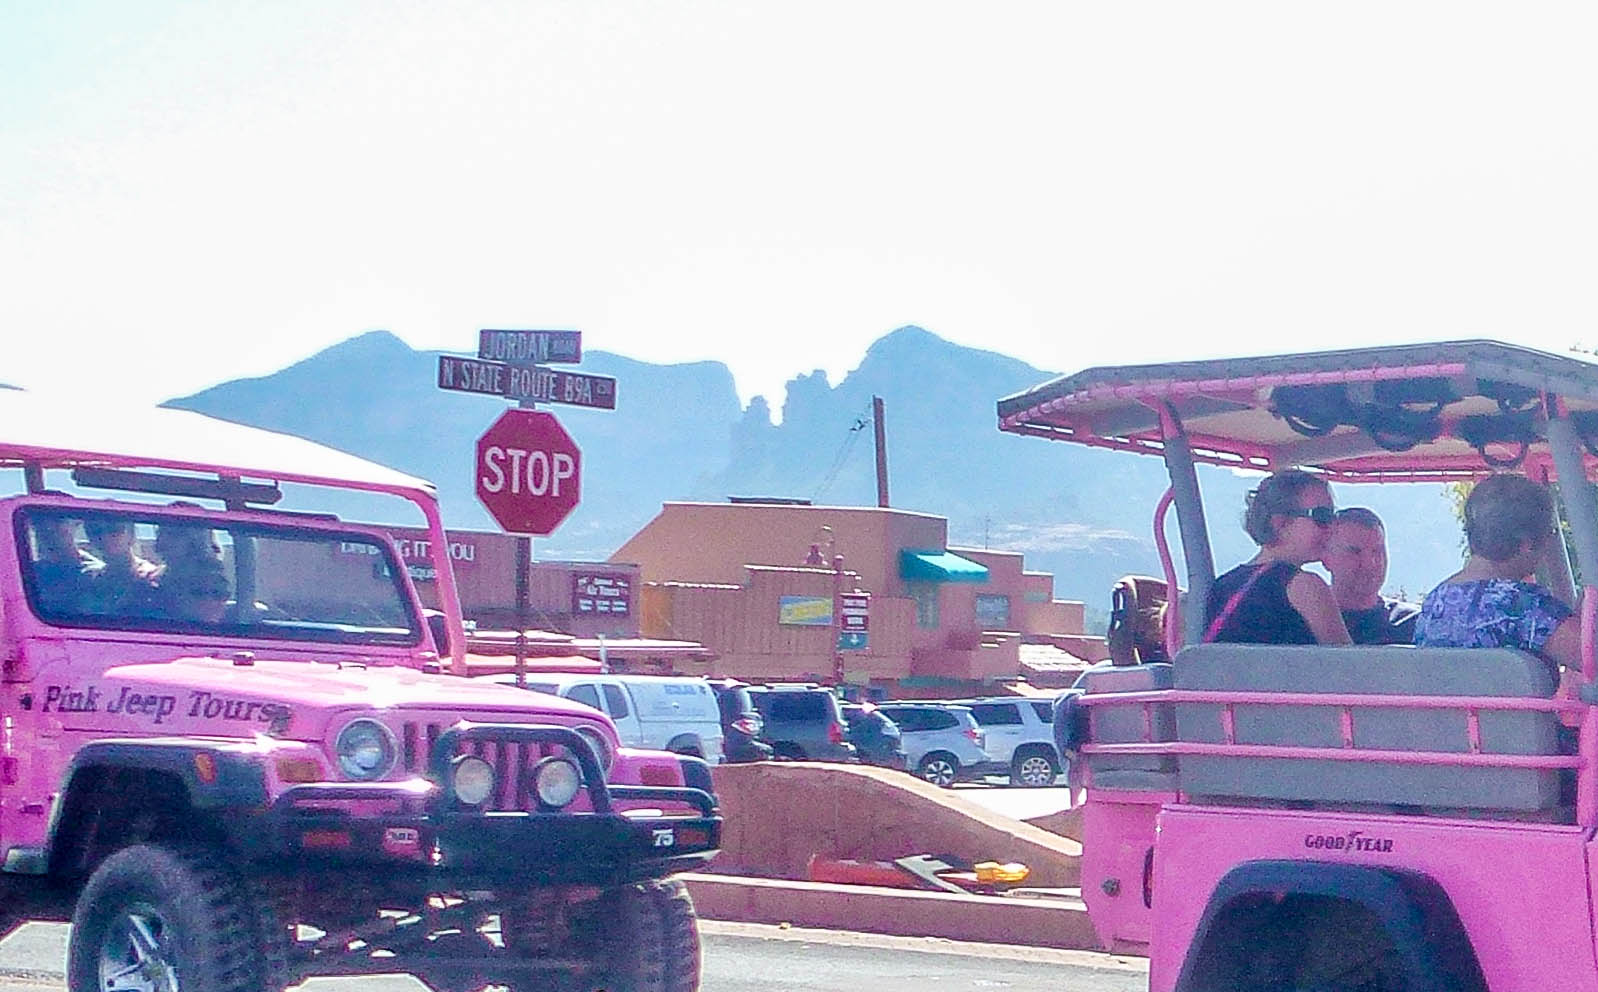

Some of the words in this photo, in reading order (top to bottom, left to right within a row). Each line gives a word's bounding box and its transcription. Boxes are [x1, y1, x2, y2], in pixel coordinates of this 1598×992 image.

[484, 332, 549, 360] JORDAN
[443, 359, 454, 387] N
[461, 361, 504, 393] STATE
[510, 368, 557, 400] ROUTE
[564, 376, 593, 404] 89A
[482, 446, 574, 497] STOP
[42, 680, 102, 713] Pink
[106, 686, 176, 724] Jeep
[188, 690, 274, 722] Tours
[652, 829, 674, 847] 75
